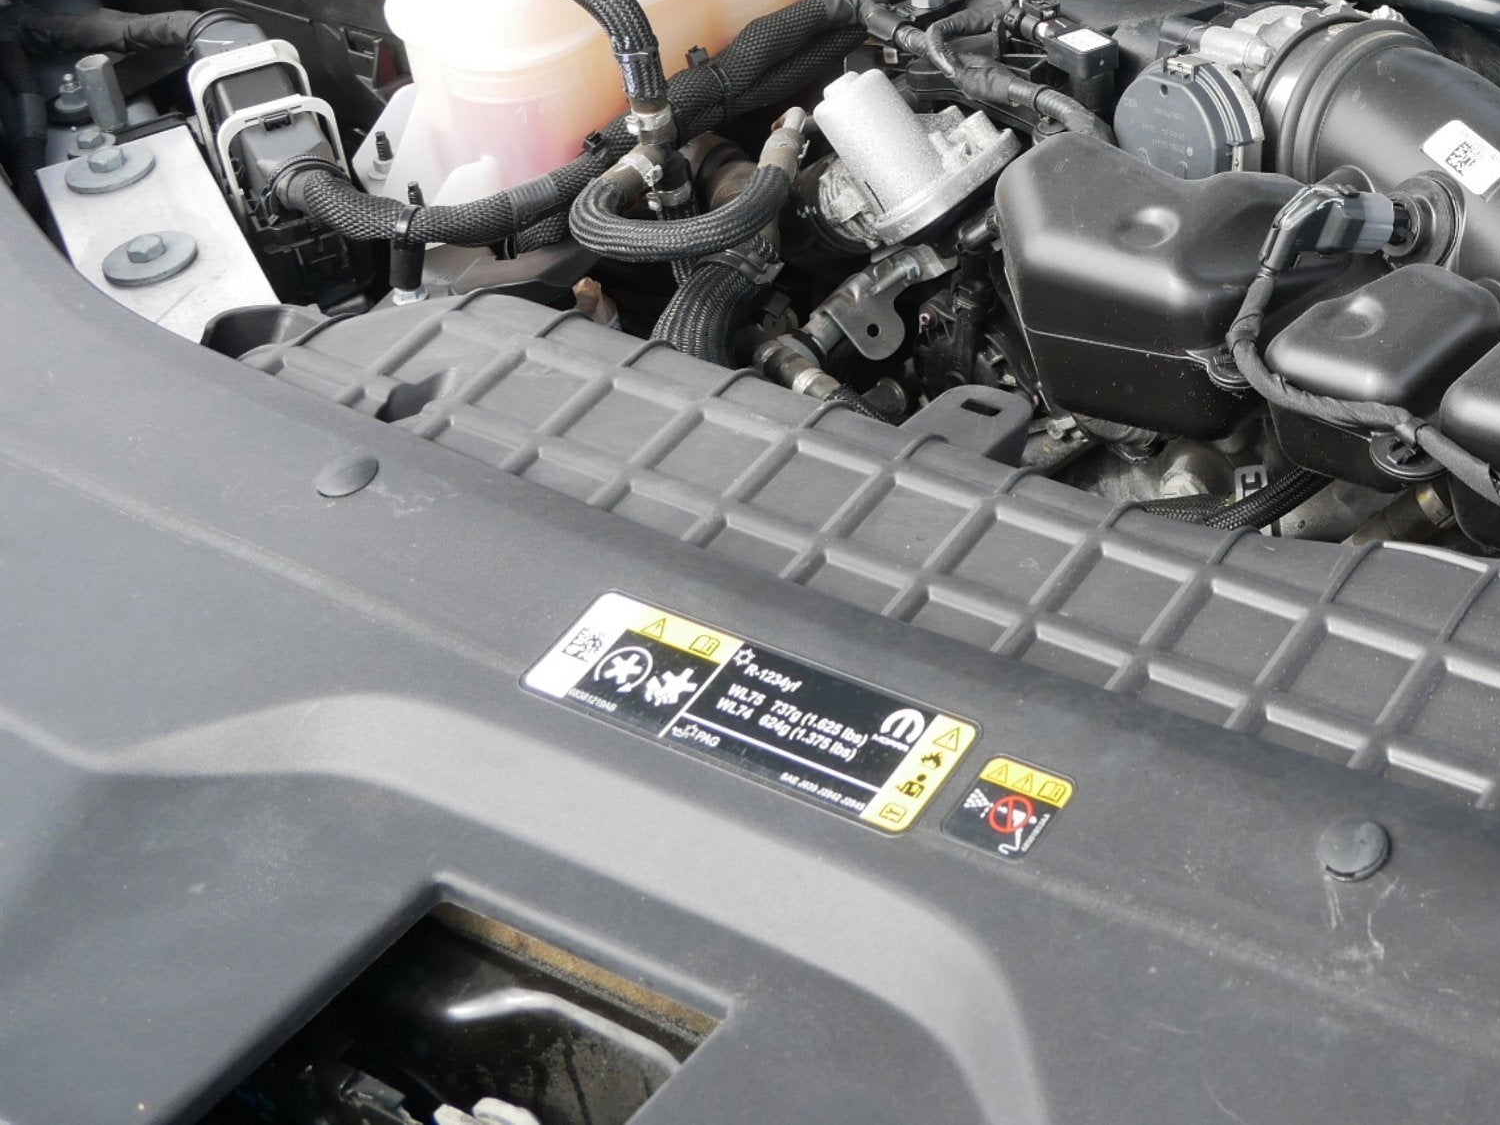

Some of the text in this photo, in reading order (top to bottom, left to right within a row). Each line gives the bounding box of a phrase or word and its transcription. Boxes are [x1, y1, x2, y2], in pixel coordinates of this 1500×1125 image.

[744, 663, 802, 693] R-1234yf
[694, 729, 721, 747] PAG
[716, 697, 858, 763] WL74 624g (1.375 lbs)
[727, 683, 868, 748] WL75 737g (1.625 lbs)
